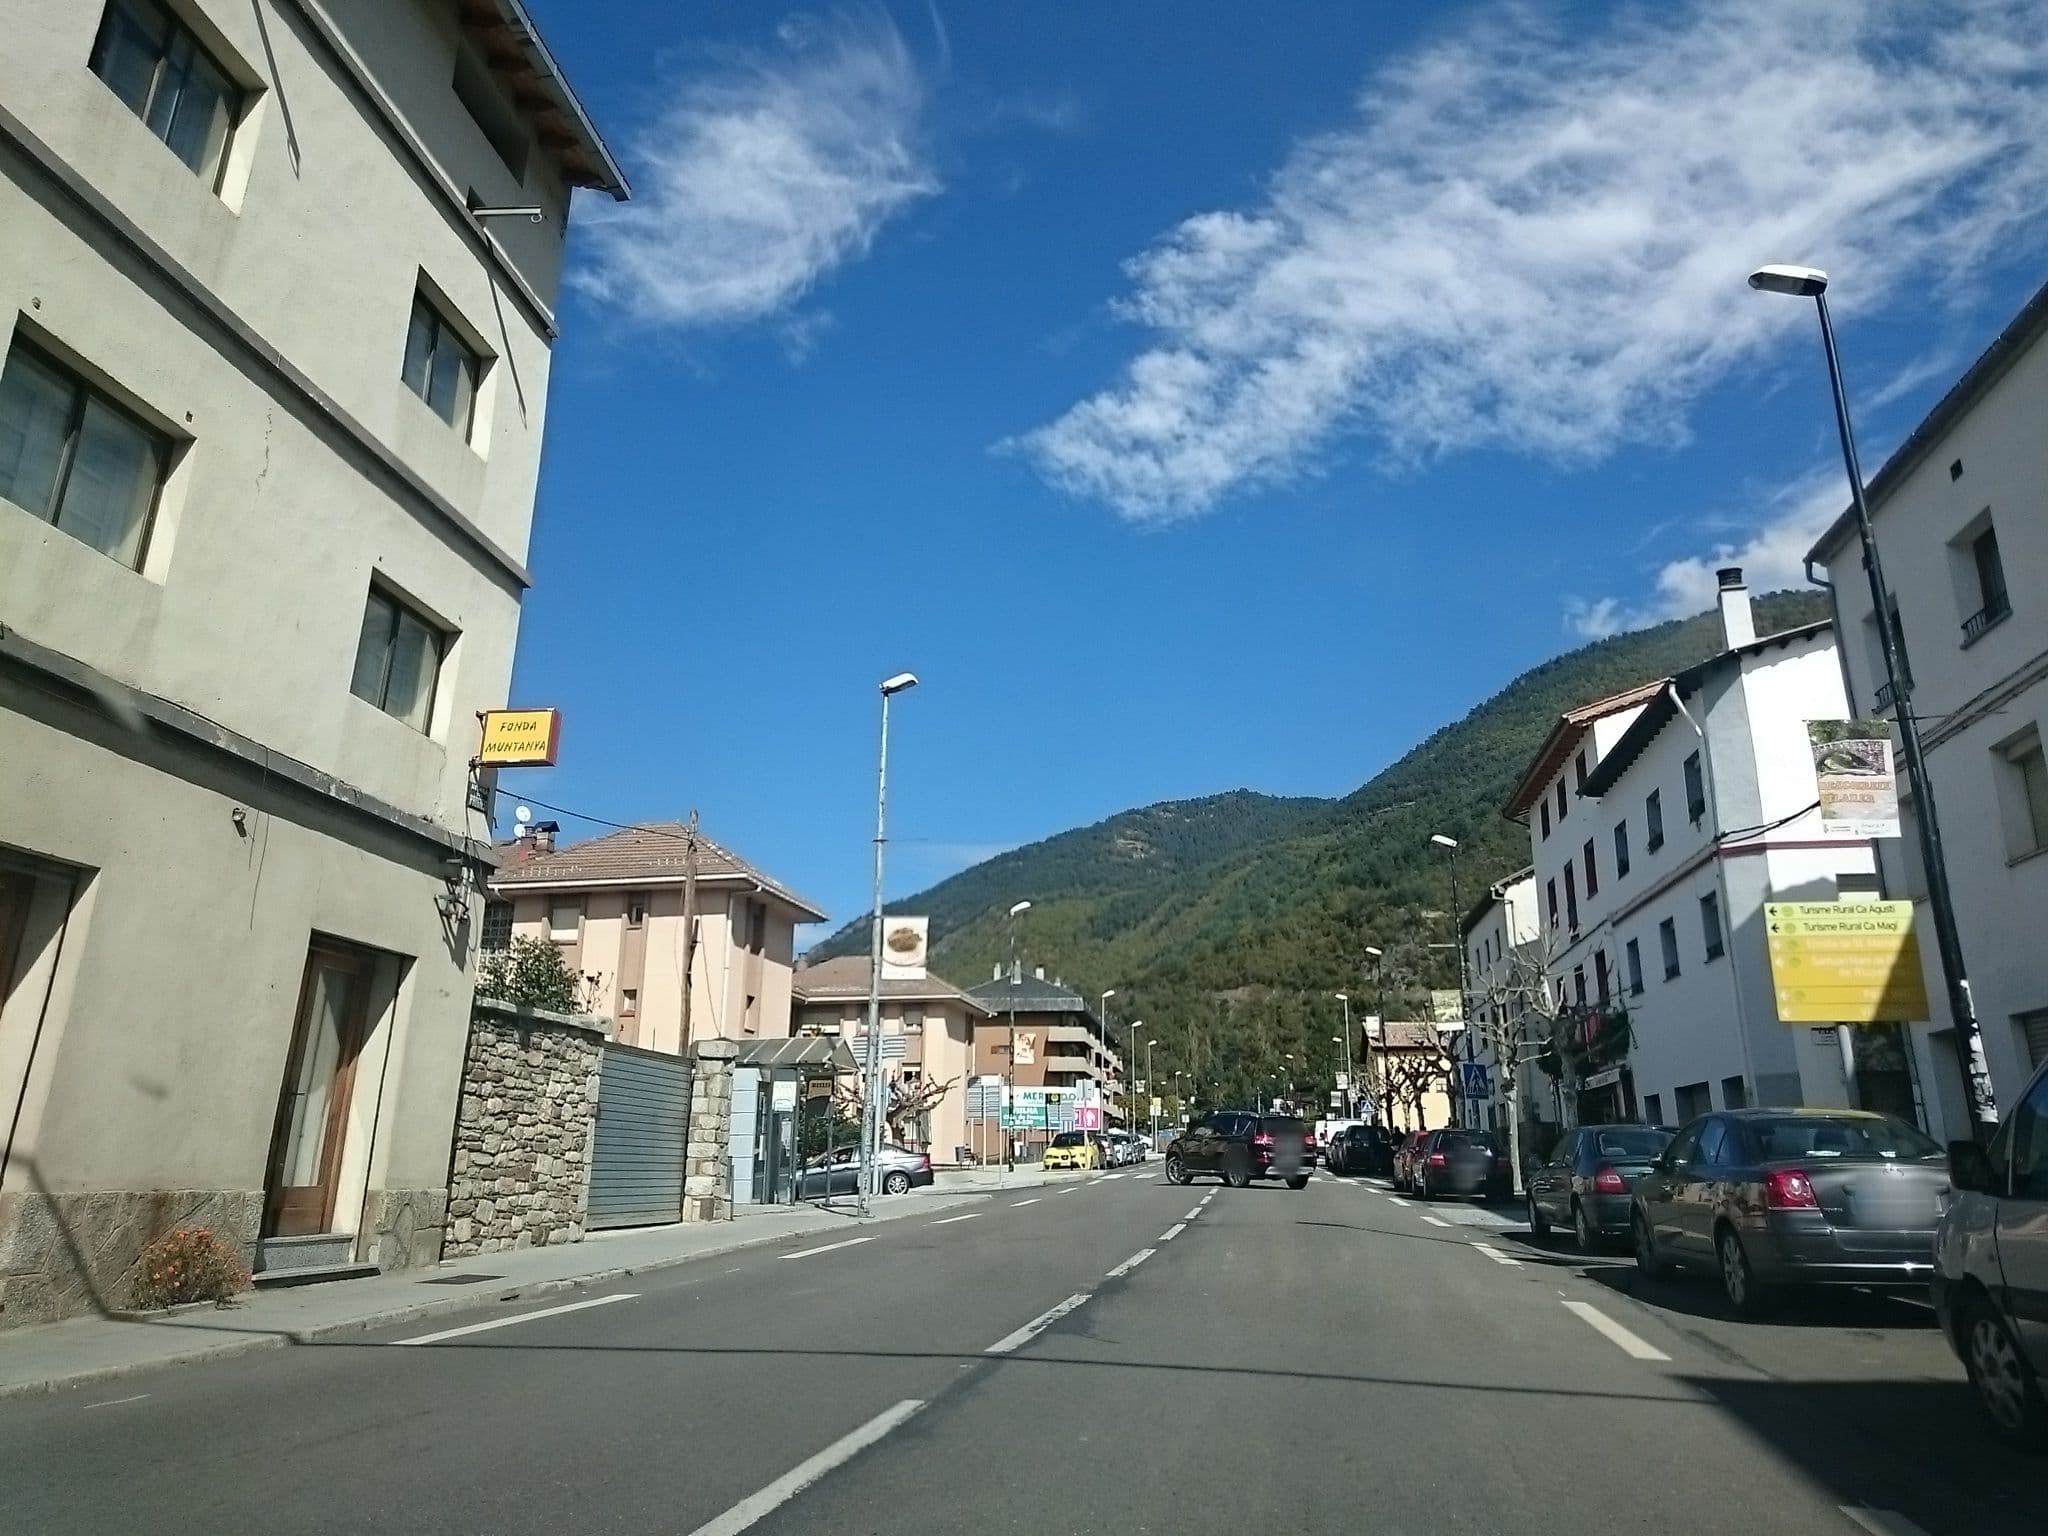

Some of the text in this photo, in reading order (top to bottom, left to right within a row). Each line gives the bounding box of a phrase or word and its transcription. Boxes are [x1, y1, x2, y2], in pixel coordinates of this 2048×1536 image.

[500, 721, 537, 732] FONDA
[485, 740, 546, 753] MUNTANYA
[1799, 905, 1831, 914] Turisme
[1832, 905, 1855, 914] Rural
[1855, 905, 1867, 914] Ca
[1803, 922, 1837, 931] Turisme
[1839, 922, 1862, 931] Rural
[1863, 921, 1875, 931] Ca
